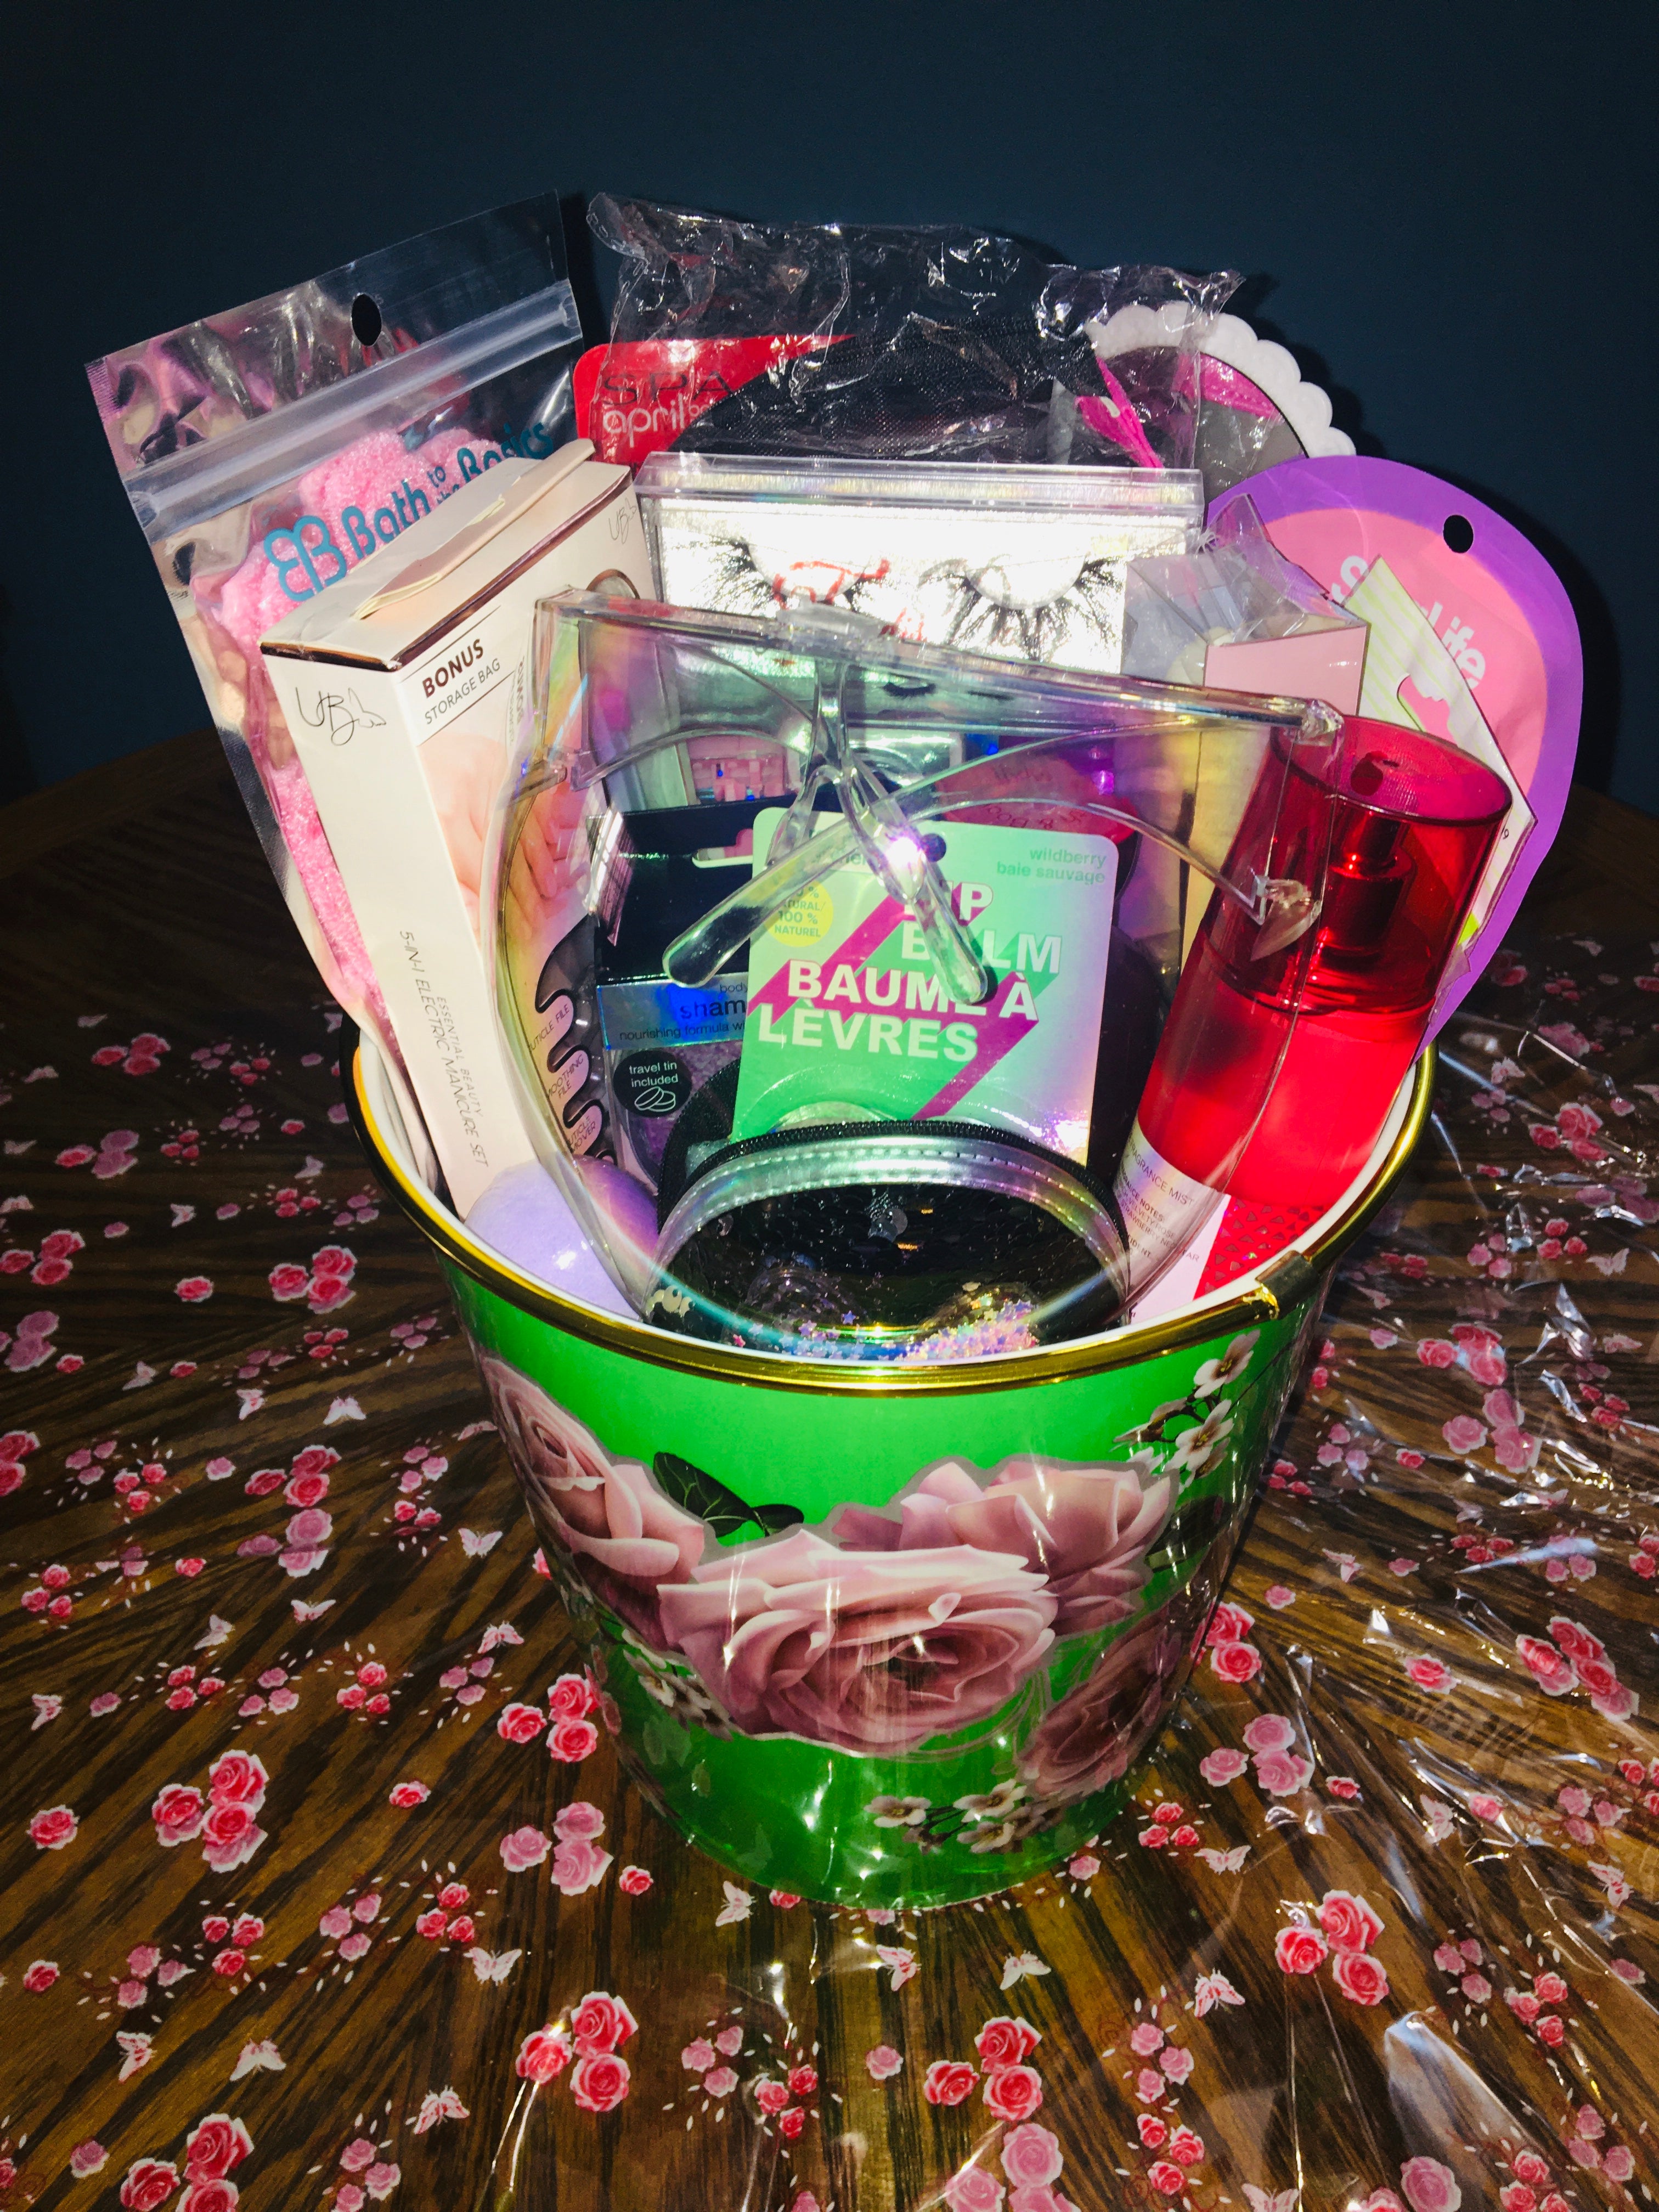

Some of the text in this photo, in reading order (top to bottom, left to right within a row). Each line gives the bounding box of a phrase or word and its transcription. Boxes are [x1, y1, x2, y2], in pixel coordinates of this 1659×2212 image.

[604, 371, 733, 405] SPA
[603, 393, 685, 447] april
[341, 479, 431, 560] Bath
[427, 466, 446, 488] to
[422, 639, 483, 698] BONUS
[425, 677, 477, 725] STORAGE
[478, 658, 500, 684] BAG
[997, 861, 1105, 885] baie sauvage
[1030, 847, 1107, 868] wildberry
[774, 924, 821, 938] NATUREL
[778, 910, 818, 924] 100 %
[901, 921, 1062, 974] BLM
[720, 983, 748, 993] body
[998, 972, 1039, 1021] À
[555, 1004, 570, 1023] FILE
[619, 1028, 681, 1041] nourishing
[686, 1024, 729, 1035] formula
[759, 998, 978, 1062] LÈVRES
[437, 996, 483, 1117] ESSENTIAL BEAUTY
[629, 1062, 677, 1075] travel tin
[416, 978, 450, 1052] ELECTRIC
[441, 1057, 479, 1139] MANICURE
[470, 1142, 489, 1167] SET
[631, 1074, 679, 1088] included
[568, 1115, 590, 1146] UTICLE
[1169, 1187, 1194, 1205] MIST
